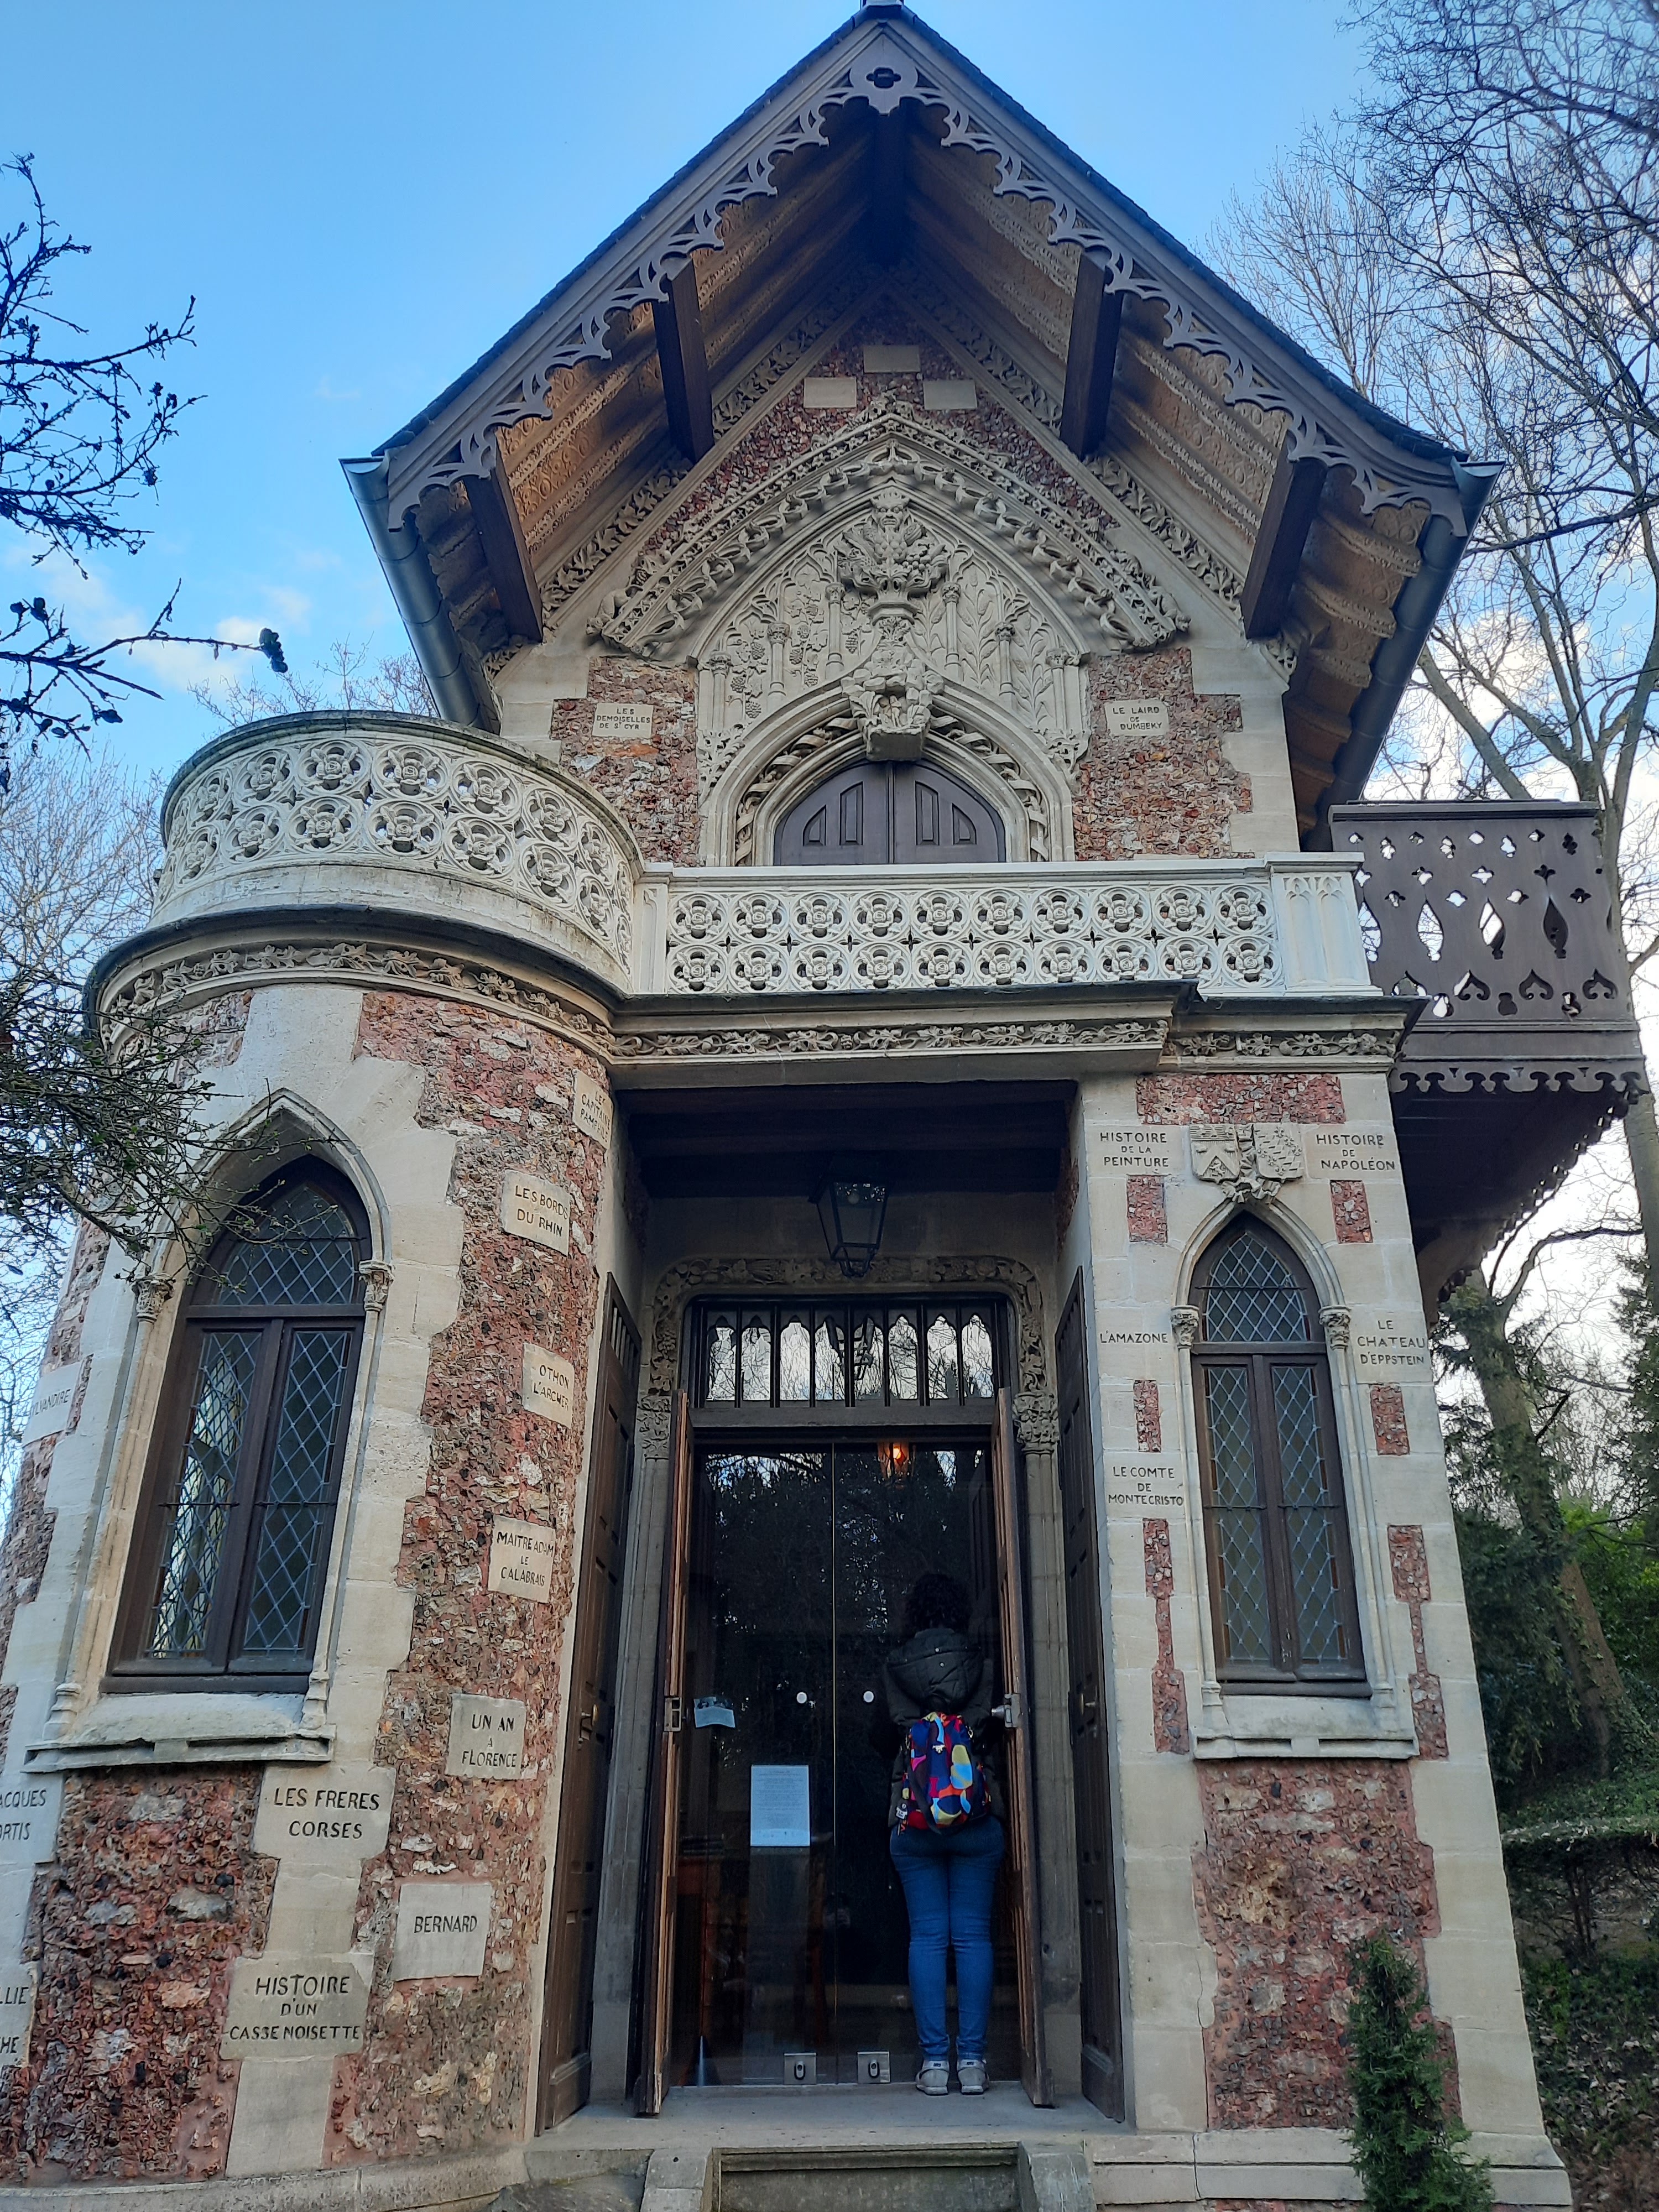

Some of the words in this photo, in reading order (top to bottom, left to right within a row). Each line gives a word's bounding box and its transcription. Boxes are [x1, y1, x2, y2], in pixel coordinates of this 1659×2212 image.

[581, 1094, 611, 1130] CAPITAINE
[580, 1108, 608, 1143] PAMPHILE
[1100, 1132, 1167, 1143] HISTOIRE
[1316, 1134, 1384, 1146] HISTOIRE
[1104, 1156, 1168, 1167] PEINTURE
[1321, 1157, 1395, 1171] NAPOLÉON
[515, 1185, 538, 1202] LES
[540, 1194, 568, 1220] BORDS
[517, 1208, 534, 1224] DU
[539, 1217, 562, 1237] RHIN
[1378, 1320, 1394, 1329] LE
[1100, 1330, 1168, 1343] L'AMAZONE
[1357, 1336, 1426, 1348] CHATEAU
[1360, 1351, 1425, 1365] D'EPPSTEIN
[539, 1365, 569, 1389] OTHON
[533, 1381, 569, 1411] L'ARCHER
[1113, 1466, 1127, 1477] LE
[1130, 1467, 1175, 1479] COMTE
[1137, 1483, 1151, 1492] DE
[497, 1531, 533, 1551] MAITRE
[534, 1540, 554, 1557] ADAM
[520, 1555, 529, 1566] LE
[500, 1567, 545, 1587] CALABRAIS
[472, 1714, 492, 1730] UN
[497, 1717, 514, 1732] AN
[462, 1749, 518, 1767] FLORENCE
[274, 1788, 307, 1807] LES
[314, 1790, 380, 1811] FRERES
[0, 1822, 30, 1840] RTIS
[289, 1820, 363, 1839] CORSES
[414, 1915, 478, 1933] BERNARD
[255, 1974, 350, 1996] HISTOIRE
[280, 1998, 317, 2016] D'UN
[229, 2026, 279, 2040] CASSE
[283, 2026, 360, 2040] NOISETTE
